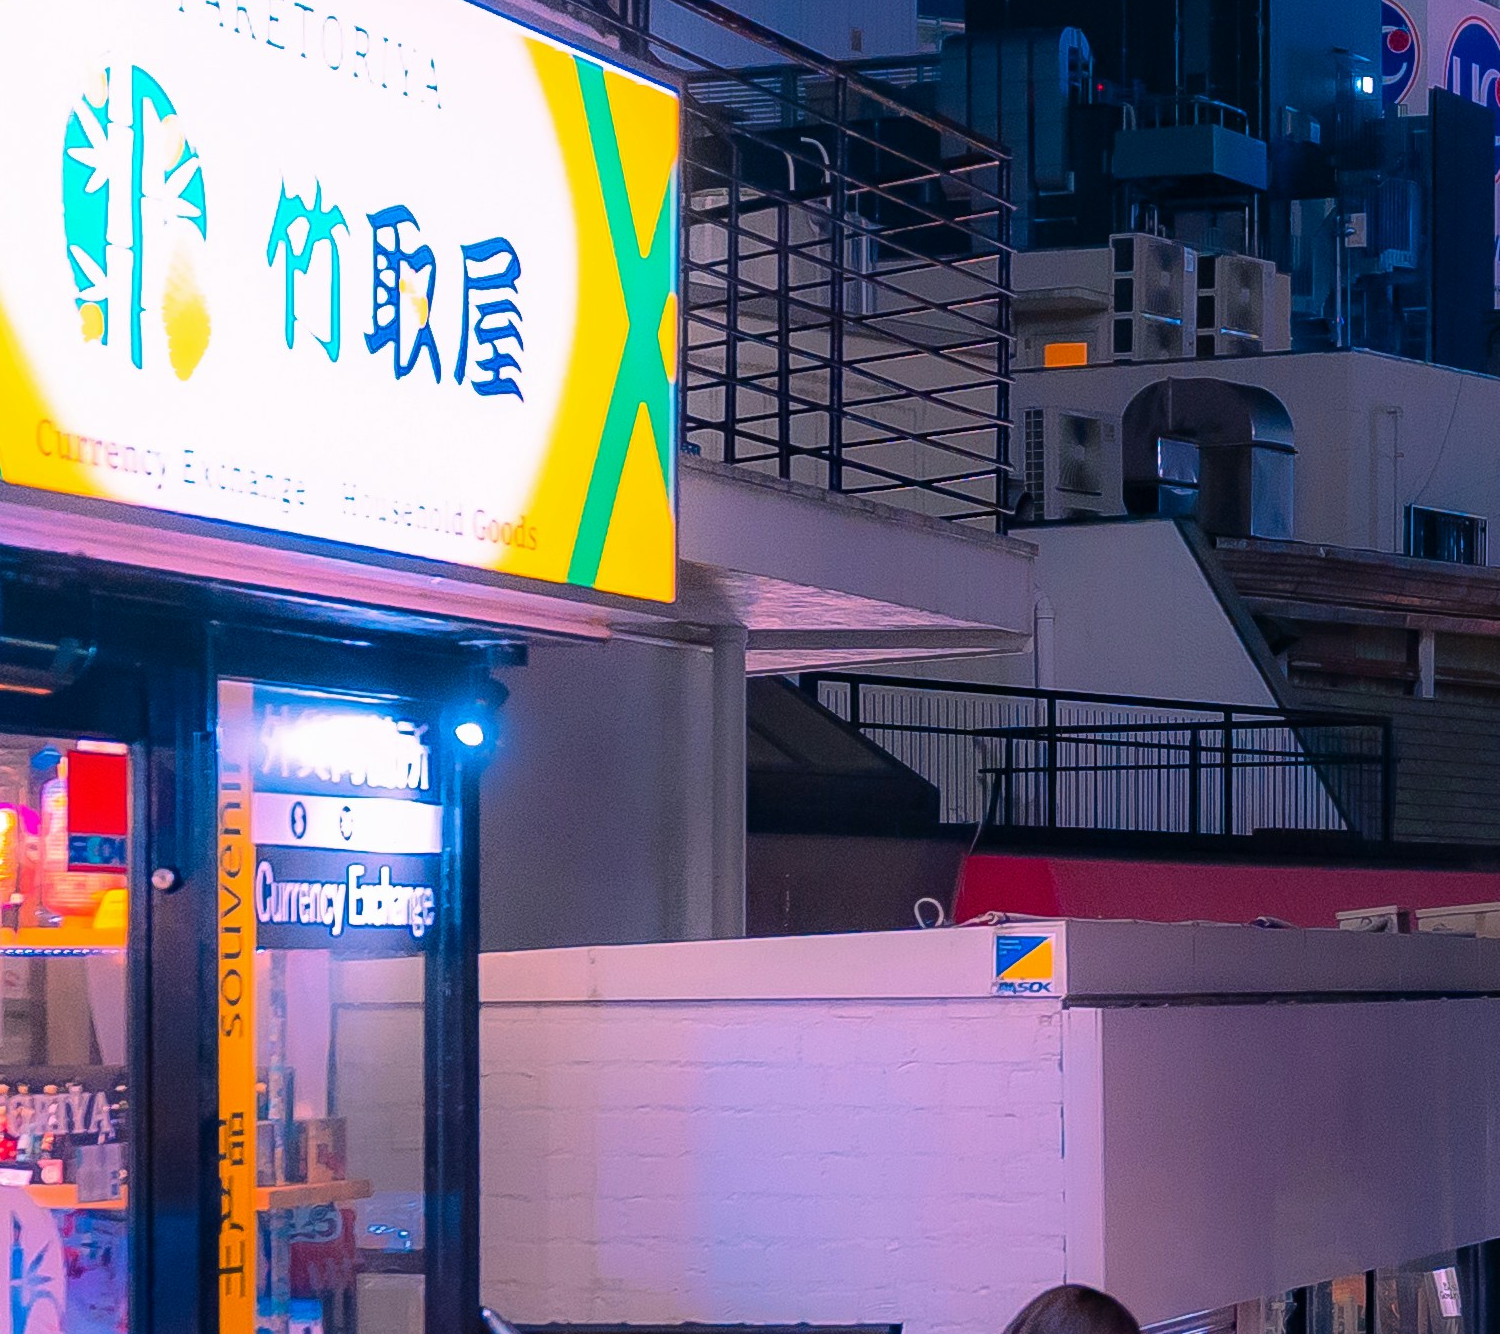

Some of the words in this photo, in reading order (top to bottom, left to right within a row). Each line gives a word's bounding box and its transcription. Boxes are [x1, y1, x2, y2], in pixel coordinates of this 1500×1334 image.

[267, 168, 525, 404] 竹取屋
[473, 509, 538, 551] Goods
[256, 861, 347, 936] Currency
[348, 863, 435, 938] Exchange
